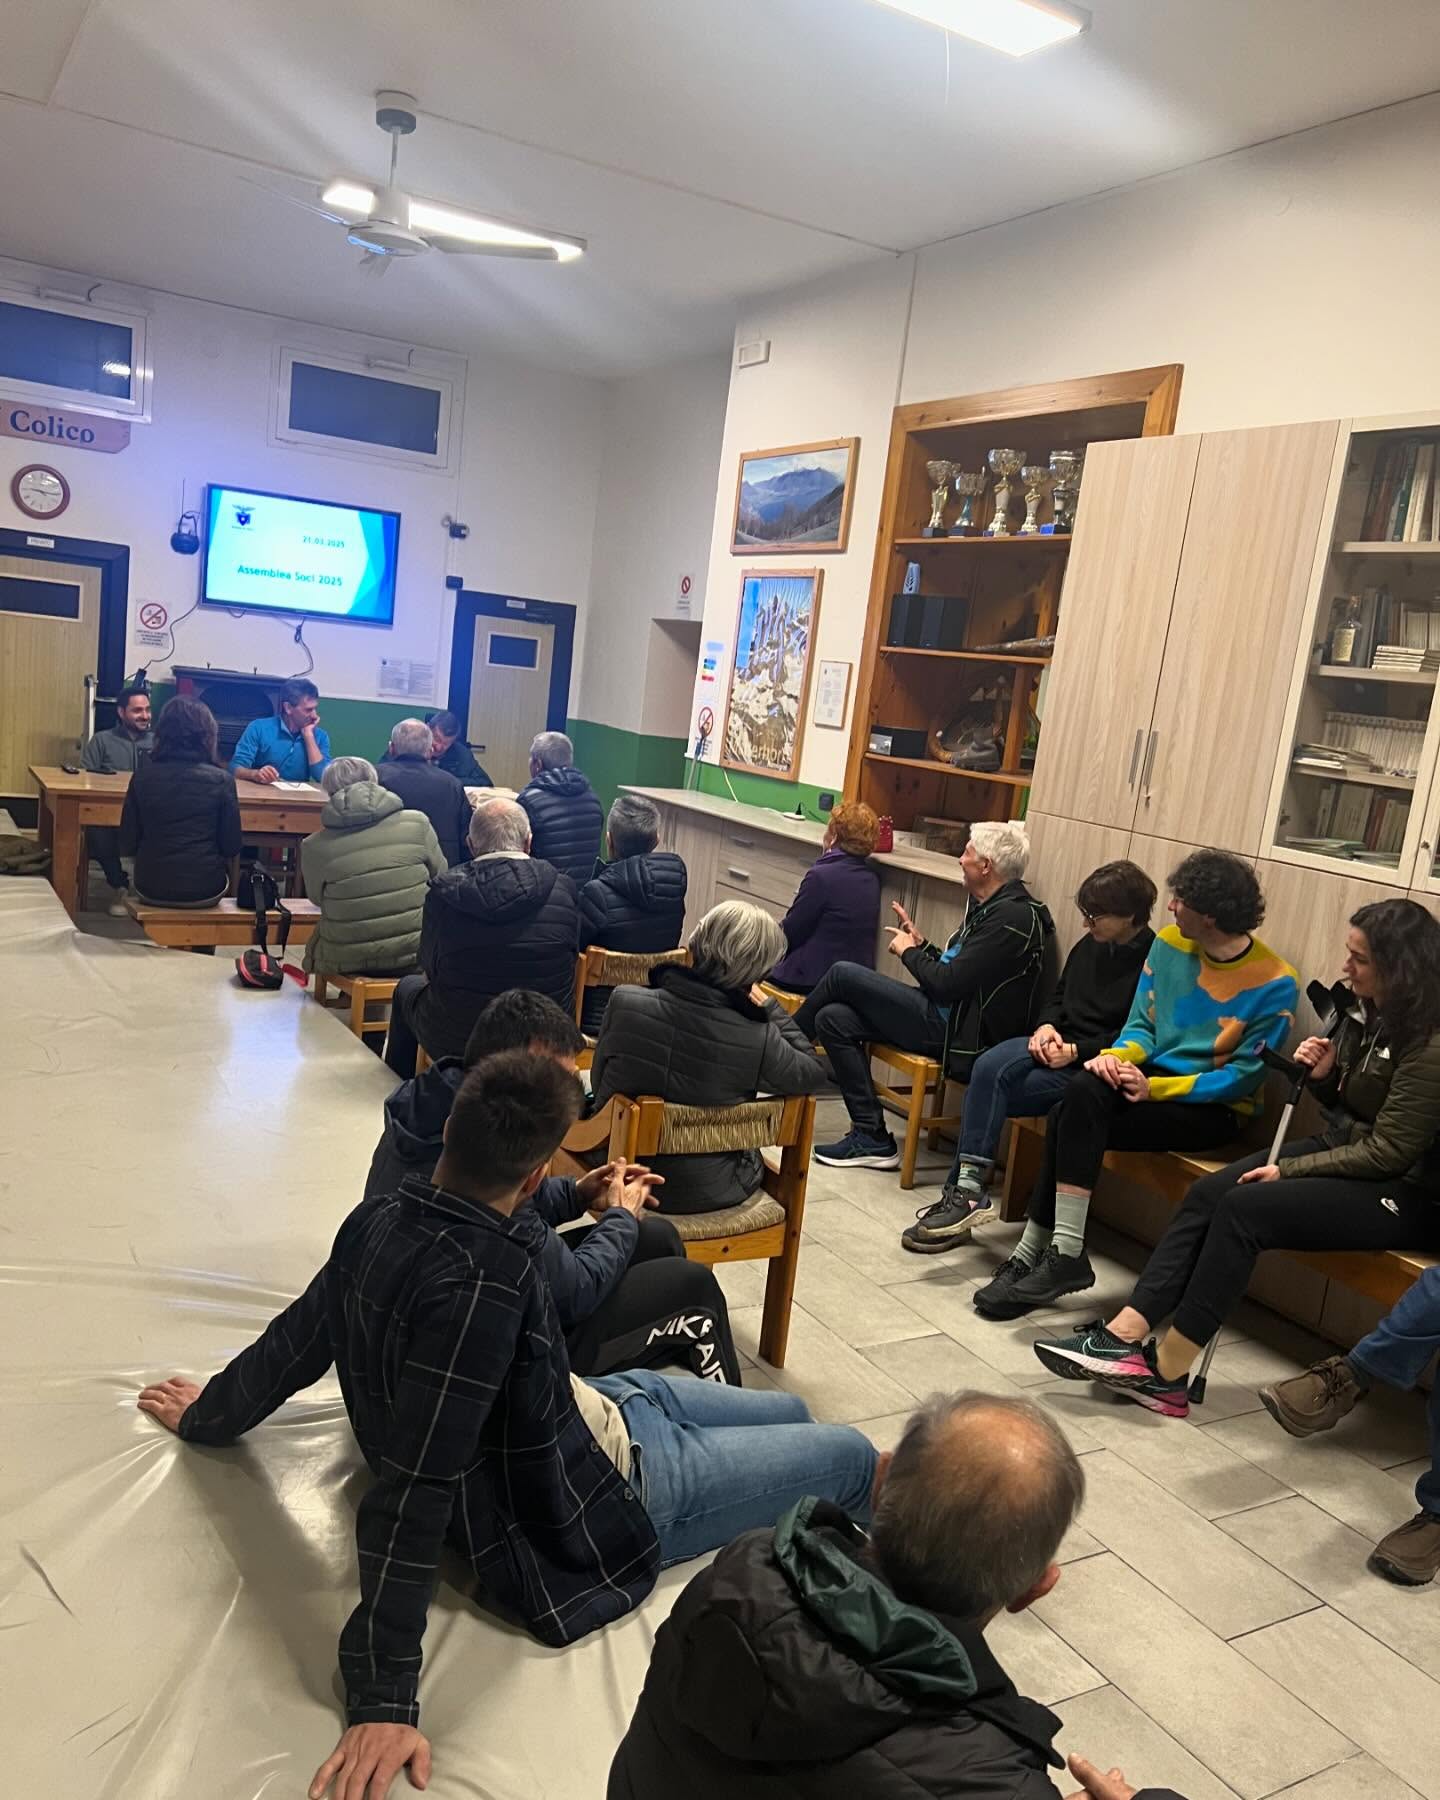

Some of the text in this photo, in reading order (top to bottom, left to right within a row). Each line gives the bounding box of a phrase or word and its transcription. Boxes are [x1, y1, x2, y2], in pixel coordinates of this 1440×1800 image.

[9, 409, 95, 443] Colico
[303, 535, 345, 548] 21.03.2025
[238, 565, 343, 587] Assemblea Soci 2025
